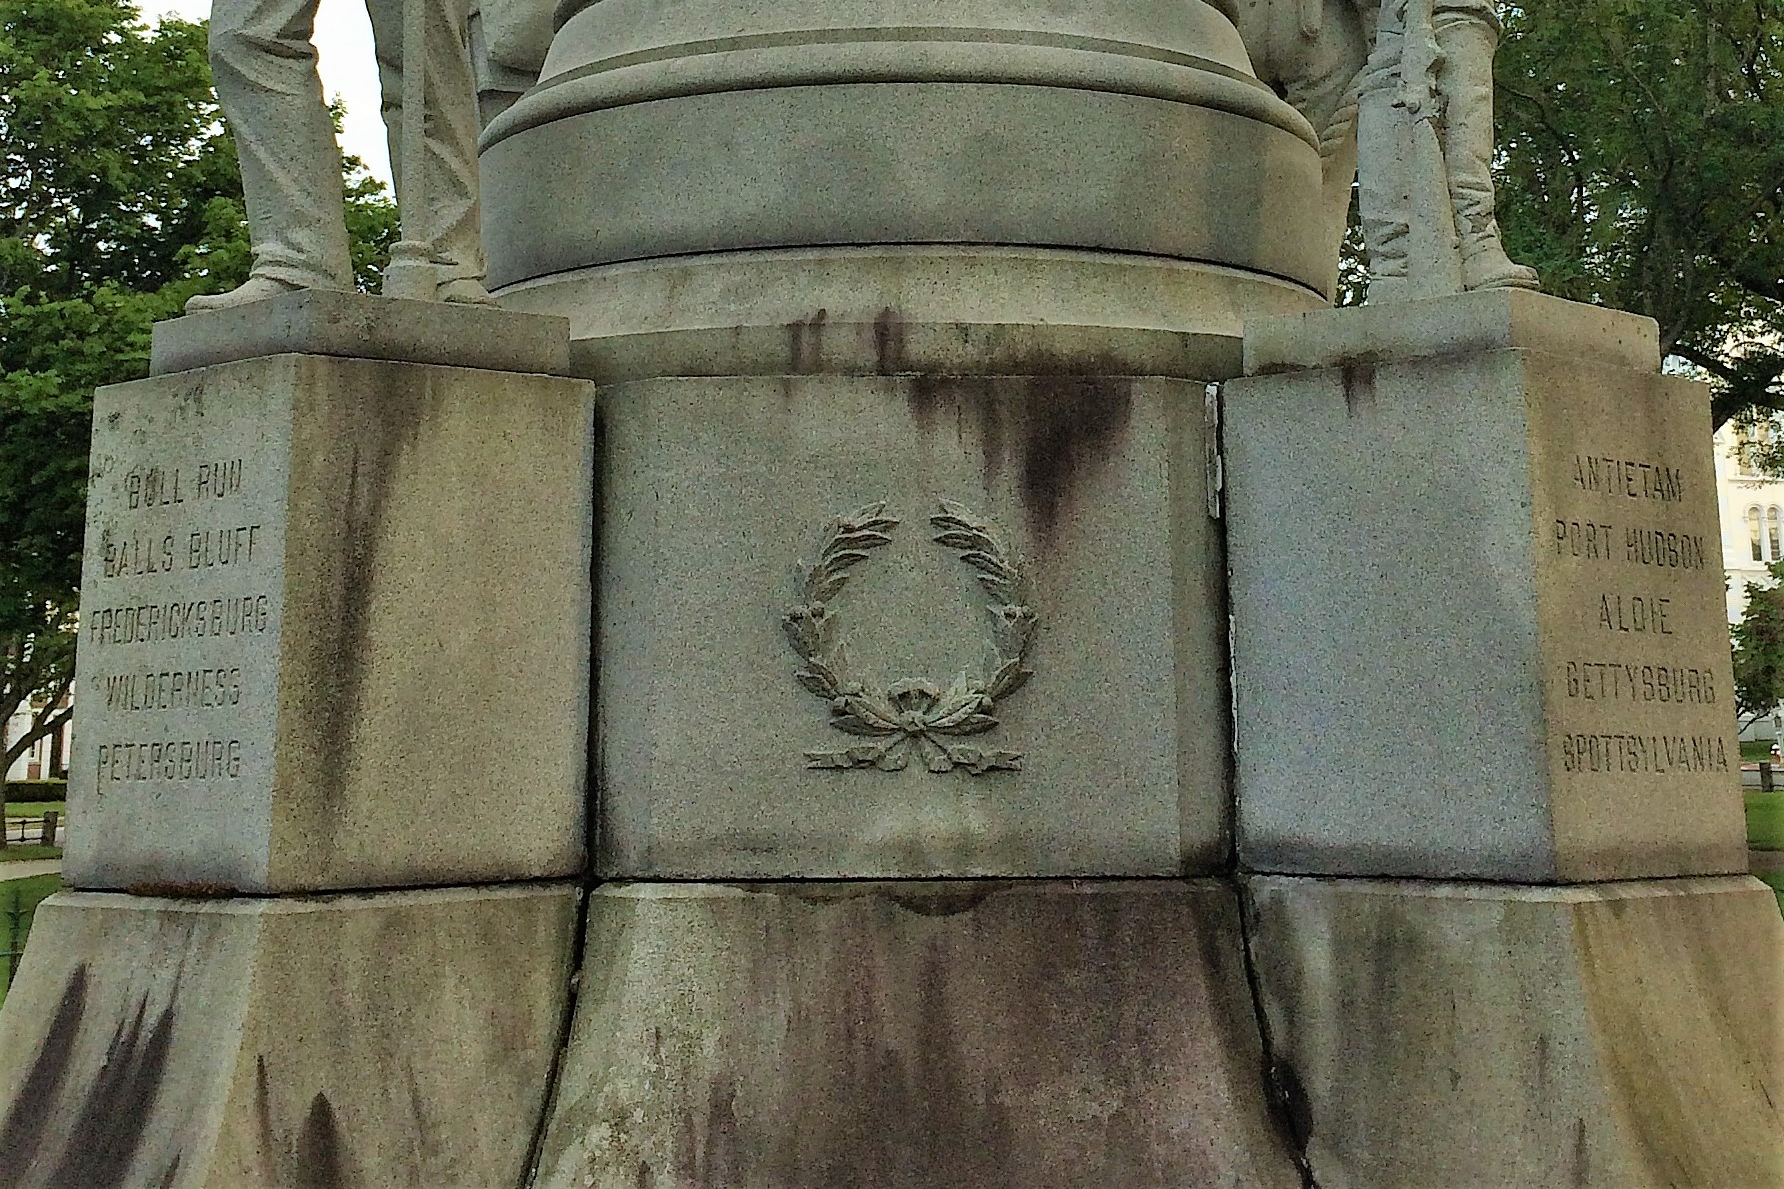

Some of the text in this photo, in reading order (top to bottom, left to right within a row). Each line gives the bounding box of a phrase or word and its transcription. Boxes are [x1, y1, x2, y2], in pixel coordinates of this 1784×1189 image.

[128, 458, 243, 509] BULL RUN
[1573, 455, 1683, 502] ANTIETAM
[103, 525, 261, 578] BALLS BLUFF
[1555, 519, 1705, 570] PORT HUDSON
[90, 594, 269, 645] FREDERICKSBURG
[1599, 593, 1673, 635] ALDIE
[106, 667, 241, 711] WILDERNESS
[1565, 660, 1716, 705] GETTYSBURG
[97, 739, 241, 783] PETERSBURG
[1562, 733, 1729, 773] SPOTTSYLVANIA
